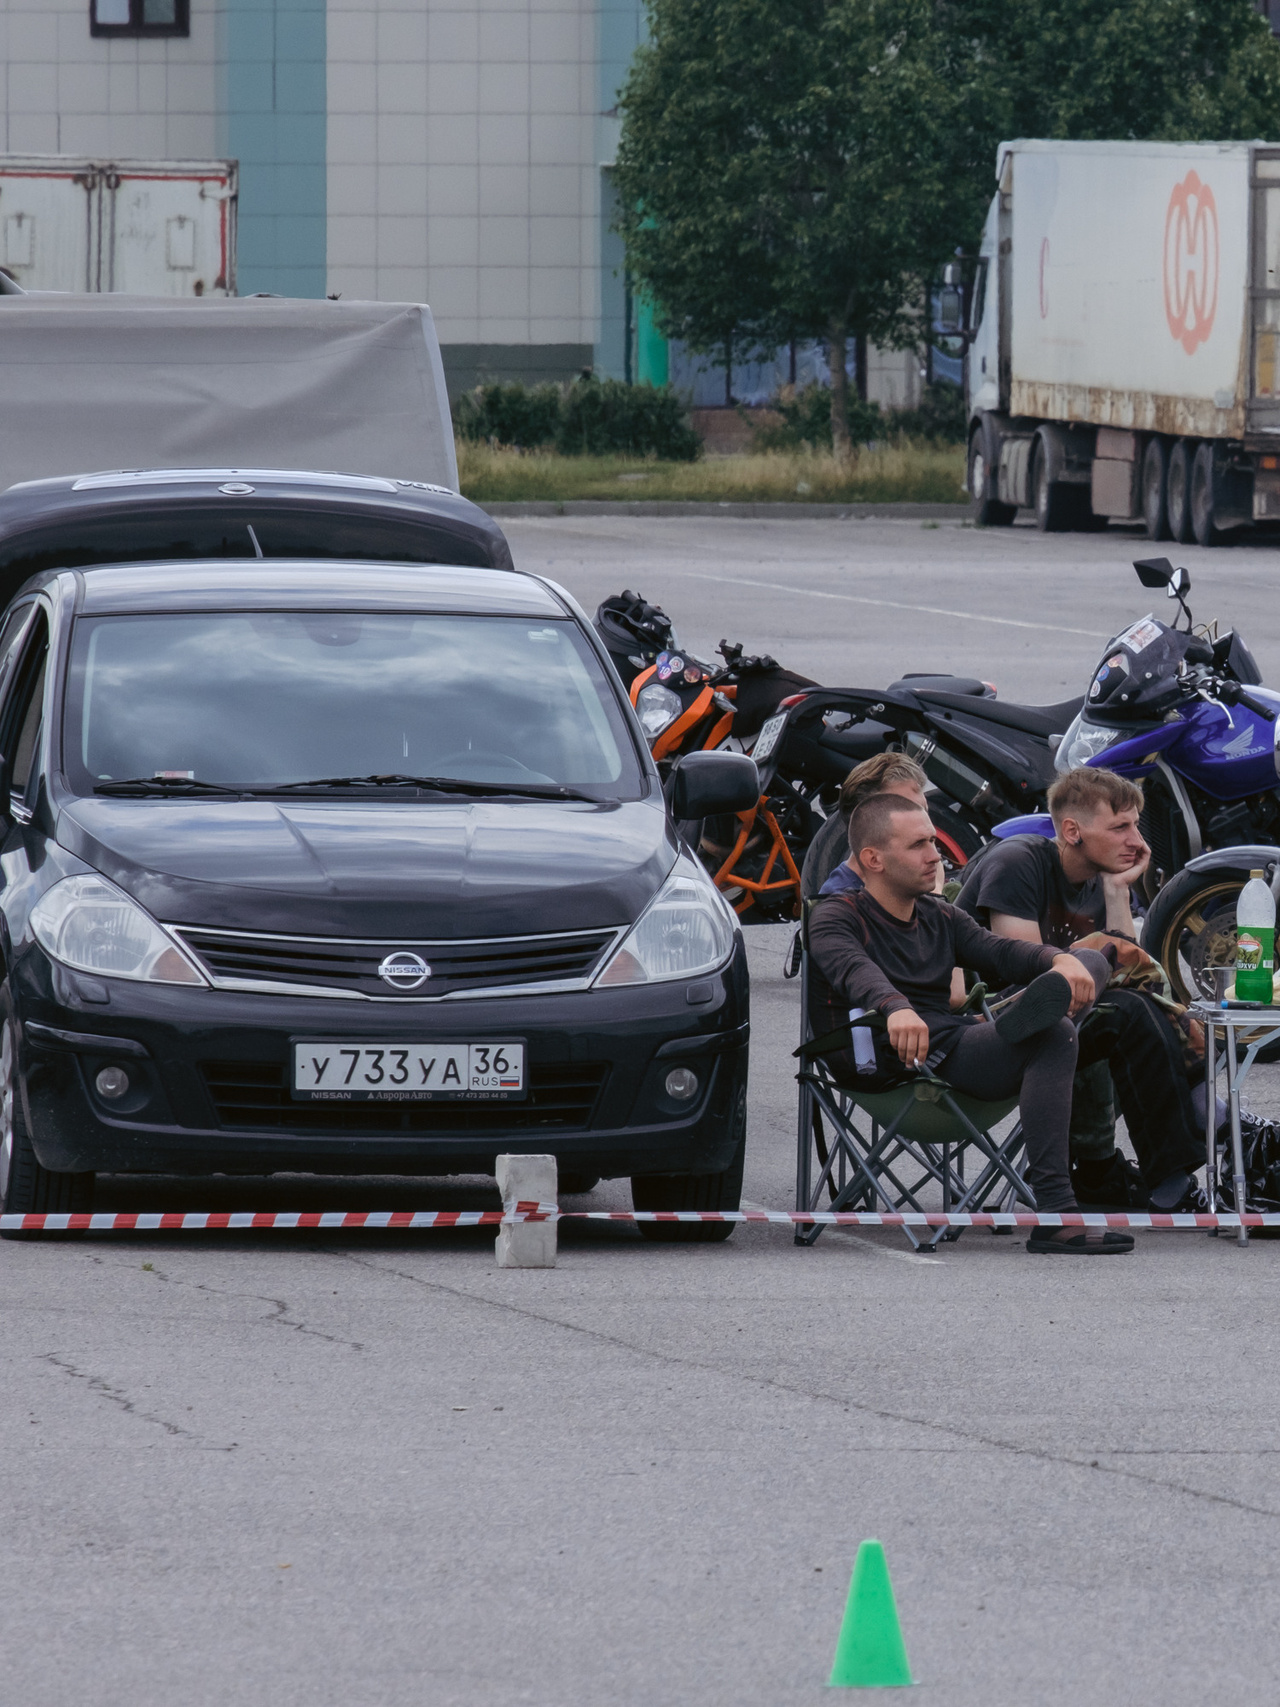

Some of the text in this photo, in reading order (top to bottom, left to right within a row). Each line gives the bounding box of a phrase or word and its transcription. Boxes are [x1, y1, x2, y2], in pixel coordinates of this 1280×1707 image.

[1225, 745, 1267, 760] HONDA
[474, 1048, 509, 1074] 36
[472, 1077, 499, 1086] RUS
[311, 1091, 352, 1099] NISSAN
